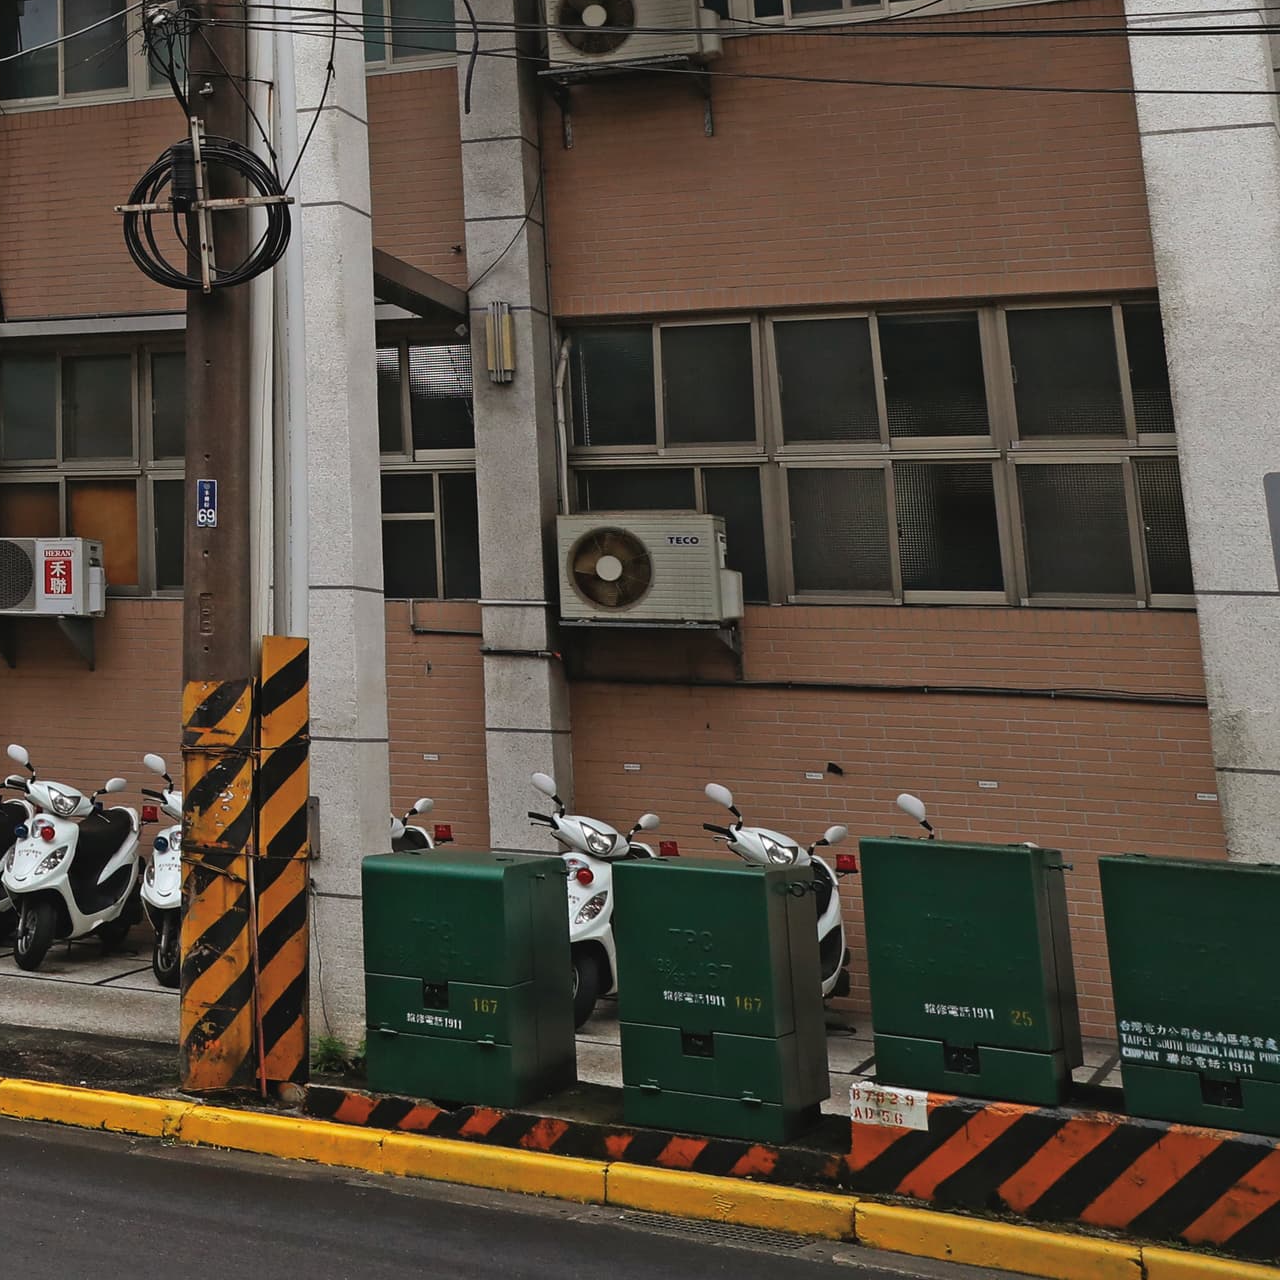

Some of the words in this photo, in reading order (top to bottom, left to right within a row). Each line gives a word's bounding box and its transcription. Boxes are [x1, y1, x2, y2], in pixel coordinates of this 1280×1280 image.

[199, 508, 215, 523] 69
[45, 550, 71, 558] HERAN
[50, 561, 67, 594] 禾聯
[472, 997, 499, 1014] 167
